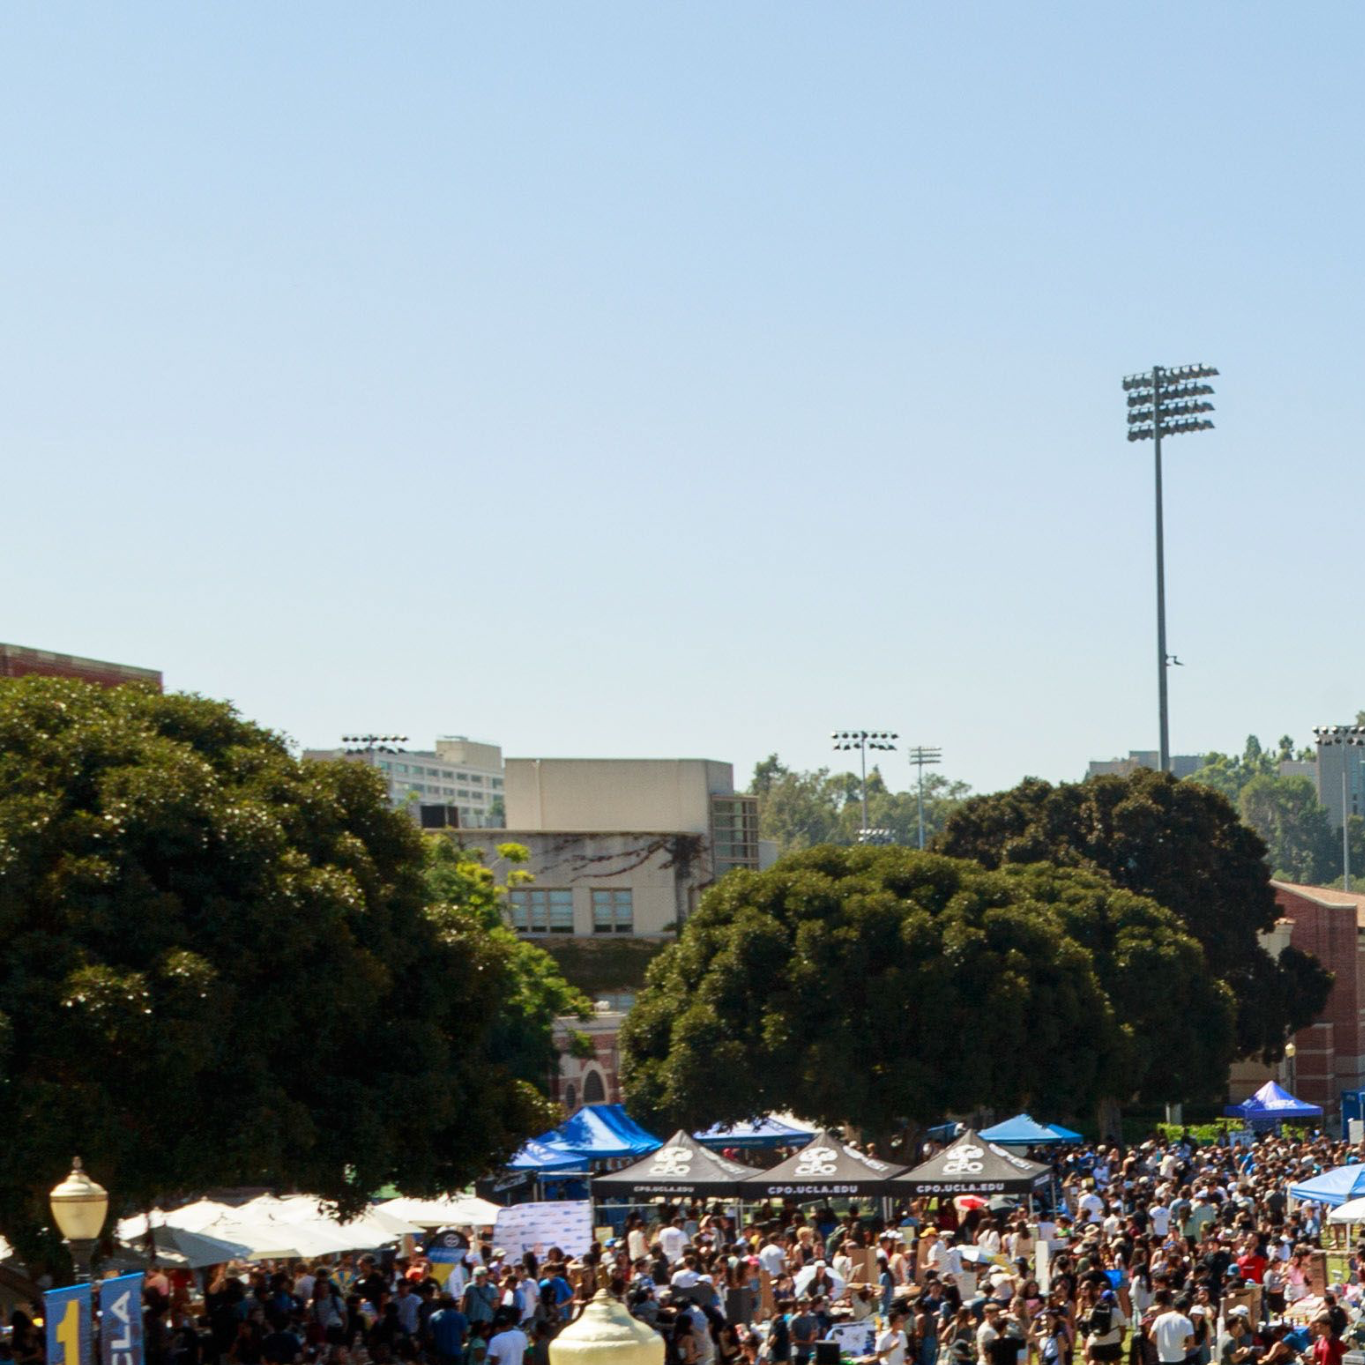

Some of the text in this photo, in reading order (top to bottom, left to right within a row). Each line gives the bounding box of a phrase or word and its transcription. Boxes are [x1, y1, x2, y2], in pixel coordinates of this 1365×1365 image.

[649, 1164, 691, 1176] CPO
[795, 1164, 838, 1175] CPO
[942, 1161, 984, 1173] CPO
[767, 1185, 859, 1194] CPO.UCLA.EDU
[916, 1183, 1005, 1193] CPO.UCLA.EDU
